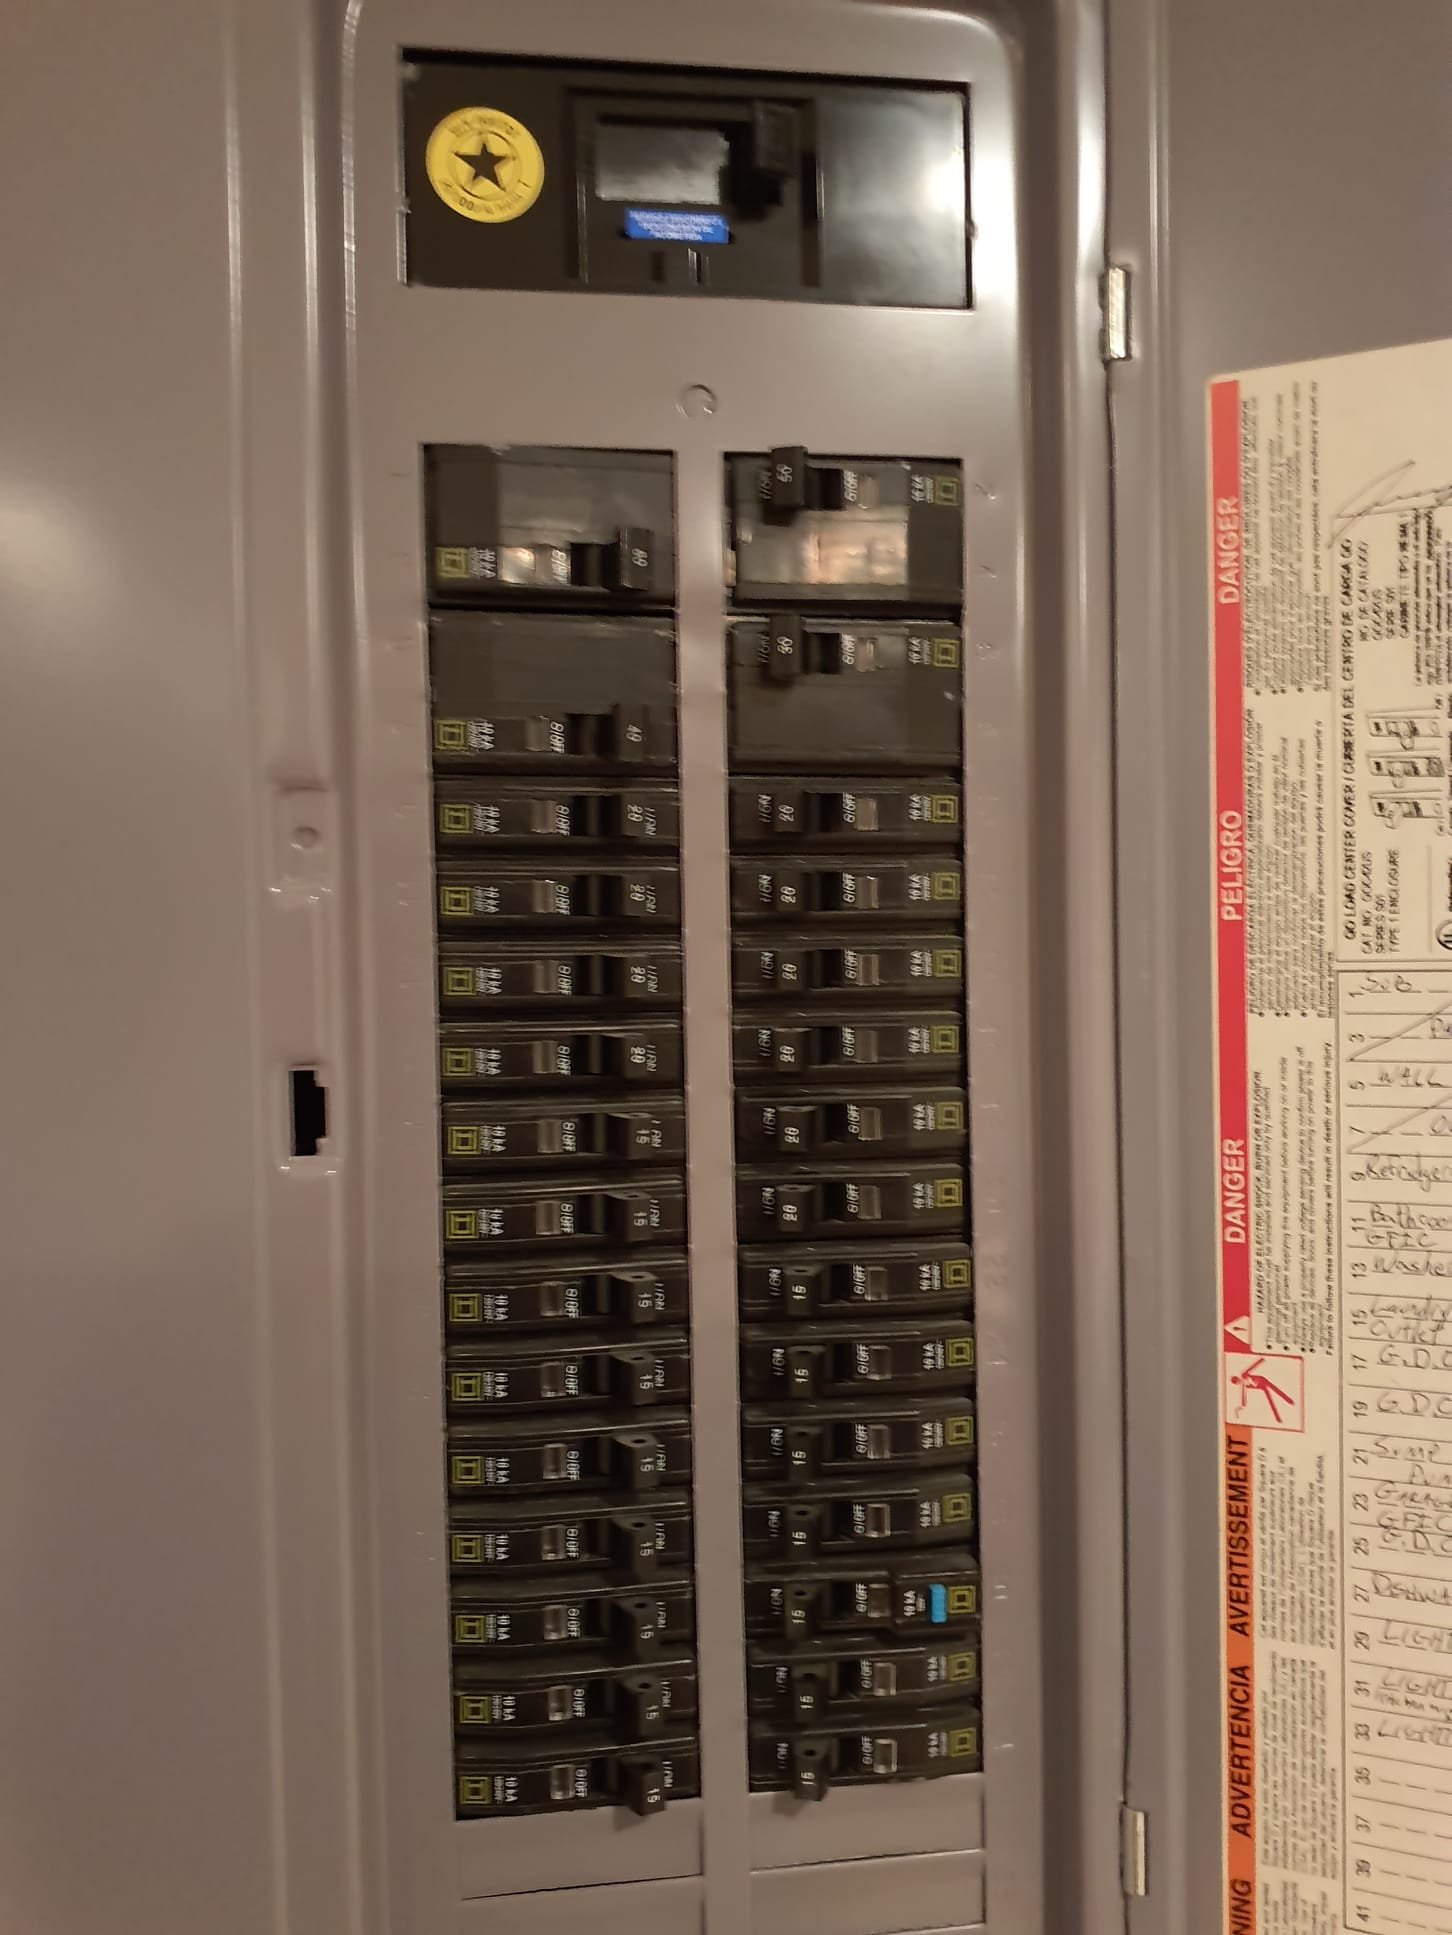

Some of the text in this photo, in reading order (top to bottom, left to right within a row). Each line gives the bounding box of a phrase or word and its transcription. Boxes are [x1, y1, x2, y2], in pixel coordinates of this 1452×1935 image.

[777, 464, 793, 483] 50
[1216, 496, 1240, 604] DANGER
[1341, 563, 1353, 606] CARGA
[1342, 611, 1353, 626] DE
[777, 636, 793, 654] 30
[1342, 630, 1354, 681] CENTRO
[1342, 686, 1354, 708] DEL
[626, 725, 642, 742] 40
[627, 805, 643, 822] 20
[779, 805, 794, 821] 20
[1343, 785, 1355, 826] COVER
[1343, 830, 1356, 879] CENTER
[1219, 810, 1243, 921] PELIGRO
[630, 884, 645, 901] 20
[781, 886, 796, 903] 20
[1344, 883, 1356, 917] LOAD
[630, 967, 646, 983] 20
[782, 963, 797, 980] 20
[1349, 992, 1363, 1000] 1
[1349, 1033, 1364, 1043] 3
[630, 1047, 646, 1063] 20
[780, 1045, 795, 1062] 20
[1323, 1071, 1332, 1103] serious
[636, 1129, 649, 1144] 15
[785, 1127, 799, 1143] 20
[1323, 1118, 1332, 1144] death
[1351, 1171, 1365, 1182] 9
[1222, 1139, 1246, 1244] DANGER
[634, 1212, 647, 1226] 15
[783, 1205, 797, 1221] 20
[1325, 1202, 1333, 1255] instructions
[1351, 1217, 1366, 1232] 11
[1350, 1262, 1367, 1279] 13
[638, 1293, 653, 1307] 15
[793, 1285, 806, 1300] 15
[1325, 1285, 1333, 1311] follow
[1350, 1309, 1367, 1326] 15
[1351, 1354, 1367, 1370] 17
[640, 1375, 654, 1389] 15
[795, 1369, 809, 1383] 15
[1353, 1401, 1367, 1418] 19
[640, 1458, 654, 1472] 15
[793, 1451, 806, 1466] 15
[1353, 1448, 1368, 1465] 21
[1353, 1493, 1368, 1511] 23
[792, 1531, 806, 1546] 15
[1227, 1436, 1250, 1637] AVERTISSEMENT
[639, 1542, 653, 1556] 15
[1353, 1537, 1369, 1556] 25
[1354, 1584, 1370, 1603] 27
[792, 1610, 806, 1624] 15
[640, 1624, 654, 1639] 15
[1354, 1631, 1370, 1651] 29
[1354, 1680, 1370, 1696] 31
[800, 1695, 814, 1709] 15
[646, 1706, 659, 1719] 15
[1354, 1724, 1370, 1741] 33
[1229, 1665, 1252, 1838] ADVERTENCIA
[802, 1772, 815, 1785] 15
[1355, 1767, 1370, 1785] 35
[647, 1788, 660, 1803] 15
[1356, 1815, 1370, 1832] 37
[1356, 1859, 1372, 1878] 39
[1356, 1906, 1370, 1922] 41
